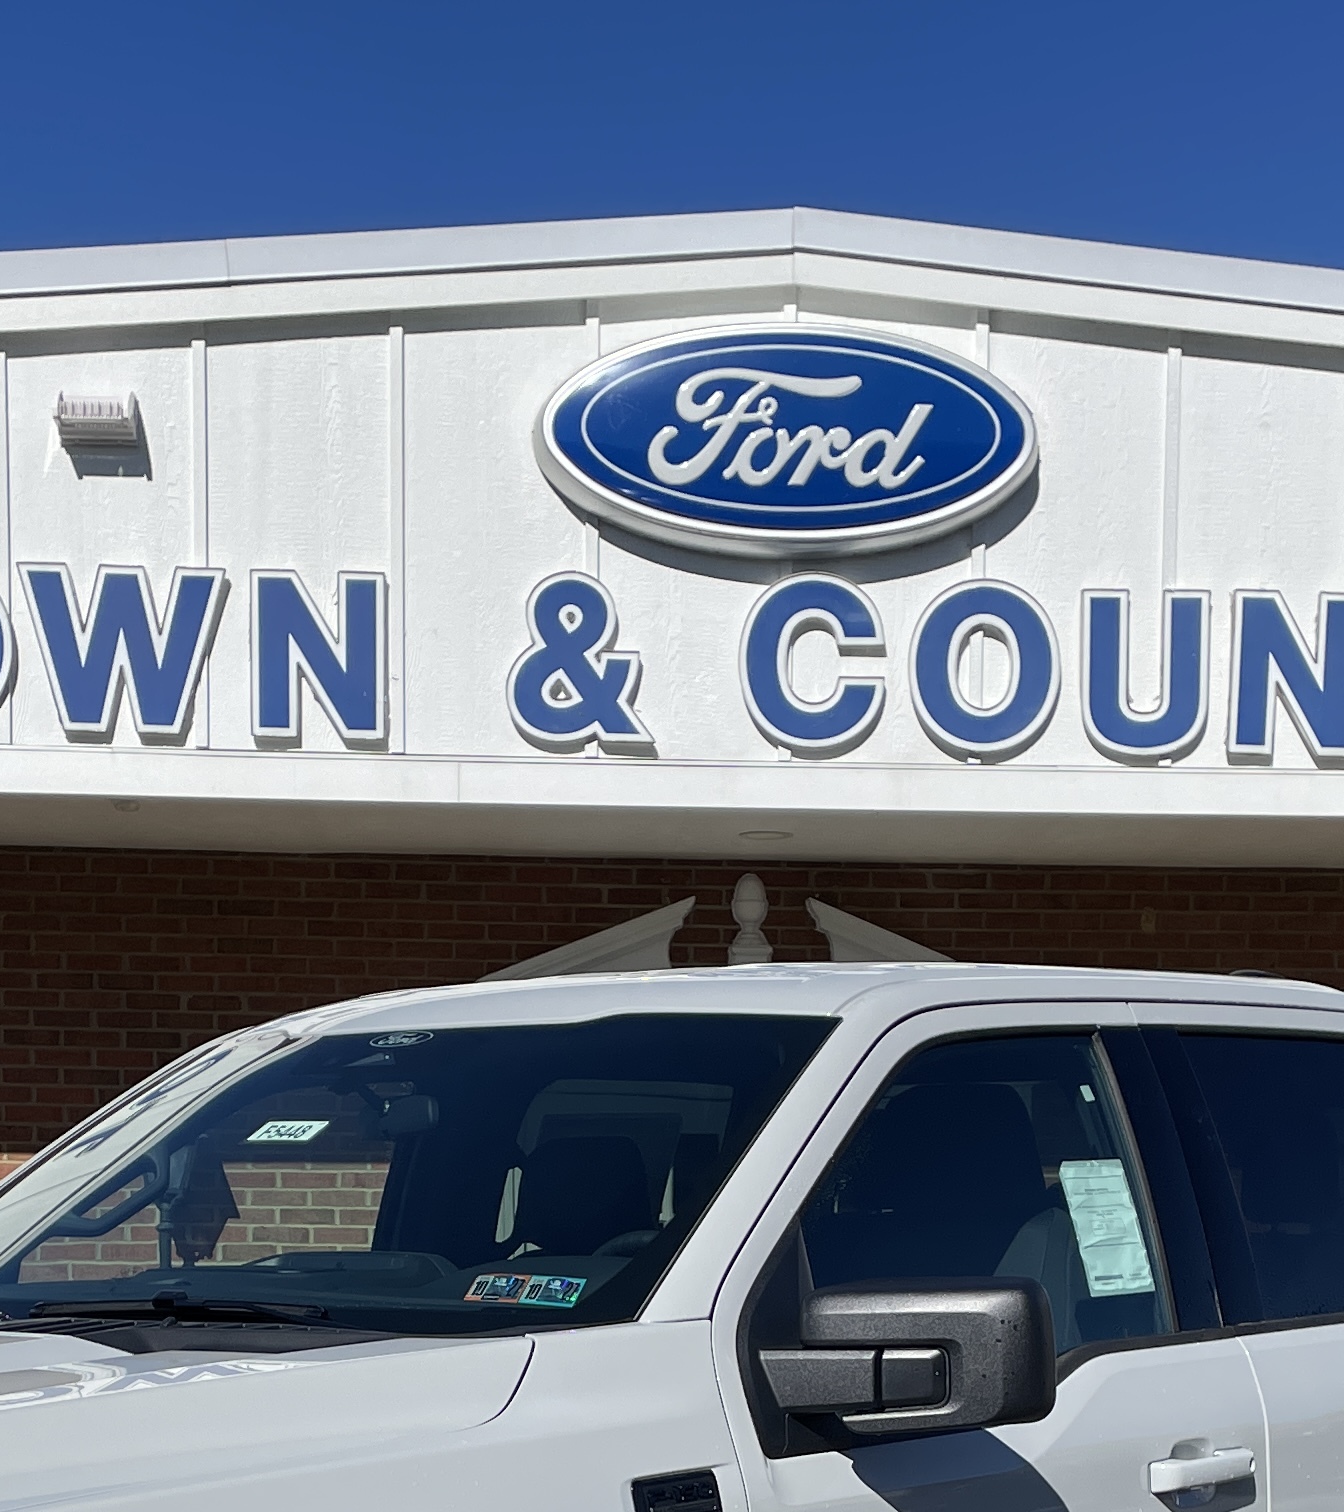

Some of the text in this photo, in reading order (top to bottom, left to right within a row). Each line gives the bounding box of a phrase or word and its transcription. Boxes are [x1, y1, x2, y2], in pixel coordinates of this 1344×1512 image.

[647, 366, 934, 490] Ford
[506, 571, 653, 748] &
[471, 1280, 490, 1296] 10
[524, 1283, 543, 1300] 10
